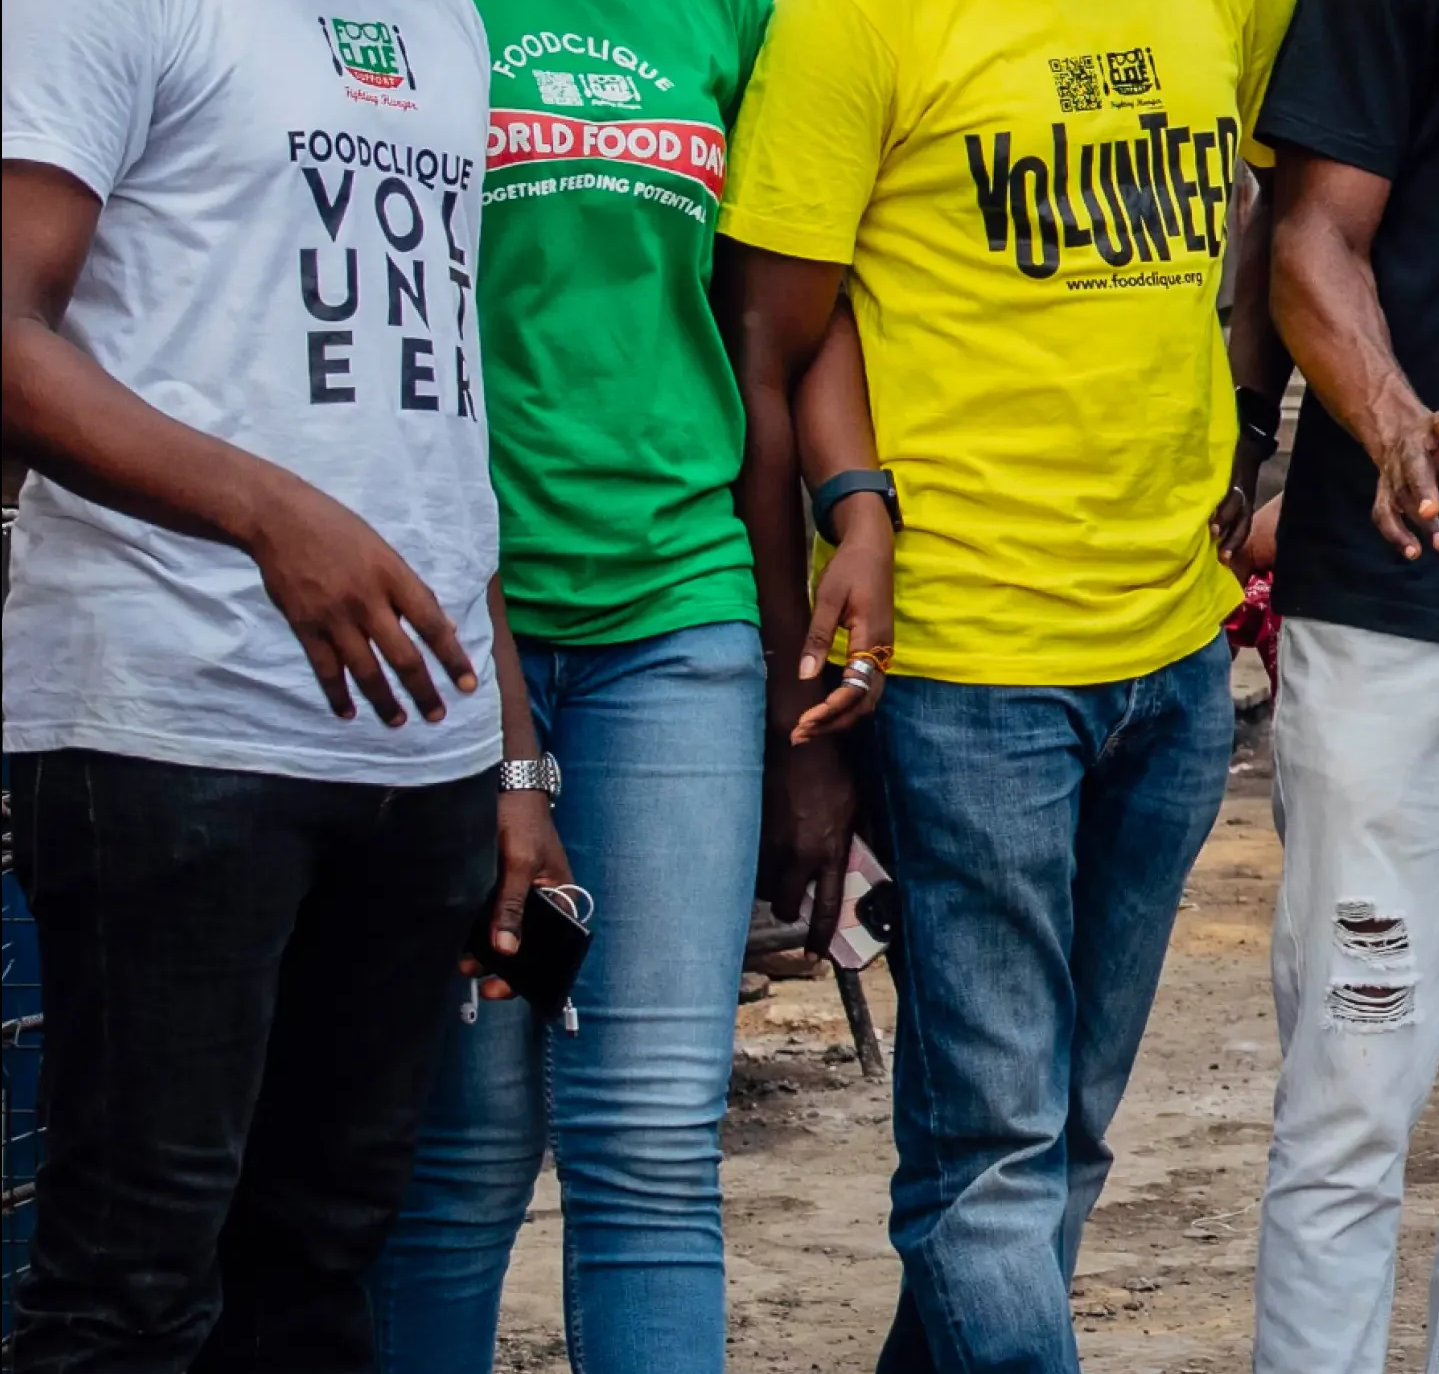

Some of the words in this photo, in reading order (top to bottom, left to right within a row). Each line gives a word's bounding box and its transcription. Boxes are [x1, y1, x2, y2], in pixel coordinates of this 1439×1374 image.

[492, 31, 676, 92] FOODCLIQUE
[287, 129, 474, 192] FOODCLIQUE
[486, 122, 574, 157] ORLD
[583, 124, 683, 161] FOOD
[481, 178, 557, 207] OGETHER
[559, 173, 630, 194] FEEDING
[1066, 270, 1204, 291] www.foodclique.org
